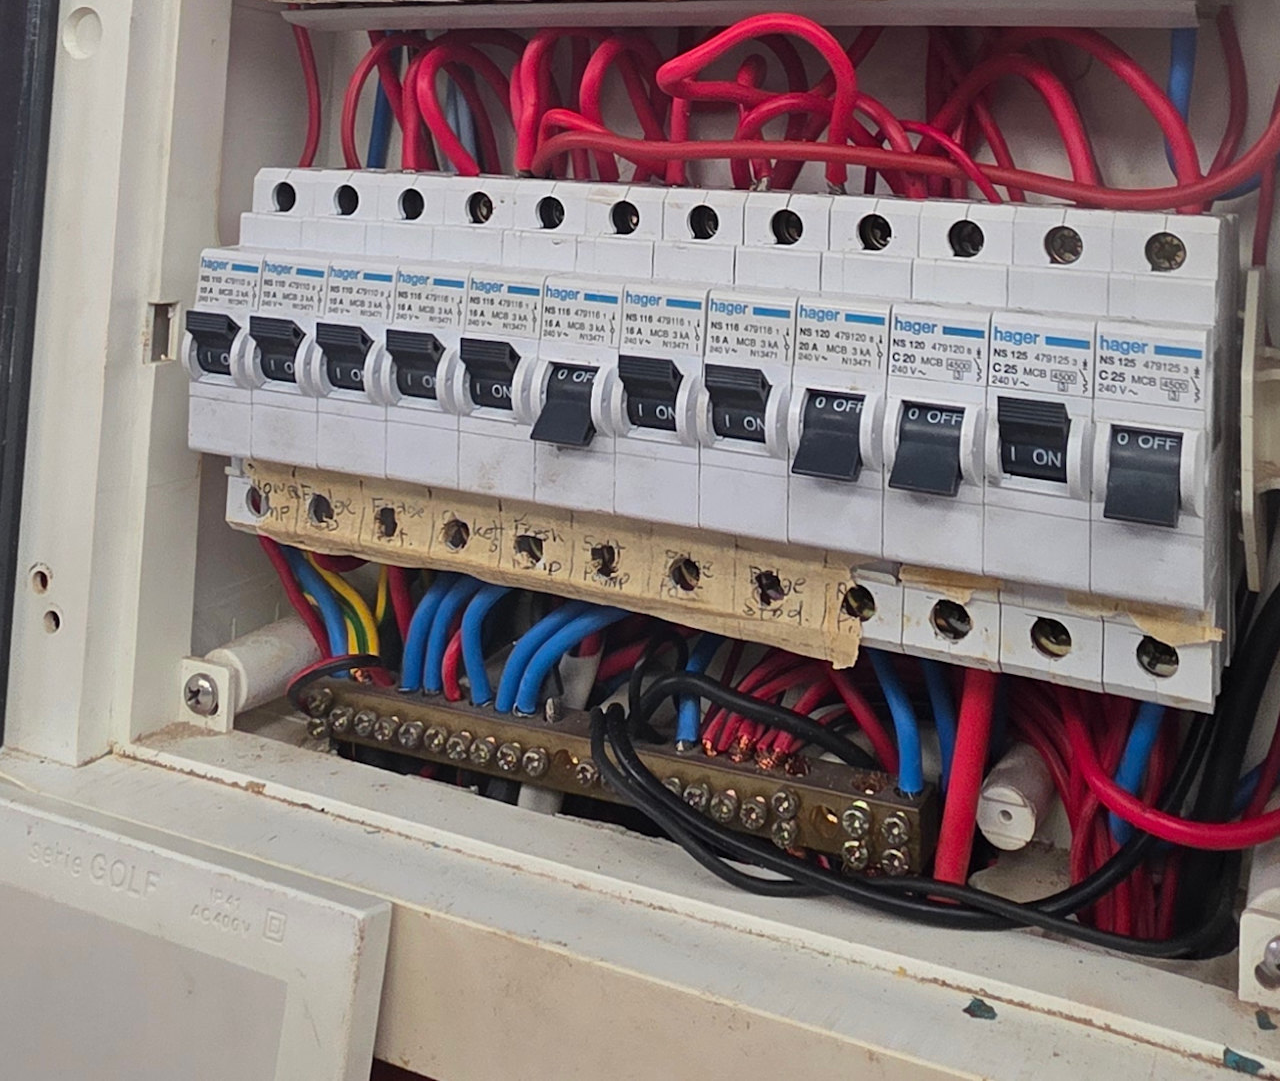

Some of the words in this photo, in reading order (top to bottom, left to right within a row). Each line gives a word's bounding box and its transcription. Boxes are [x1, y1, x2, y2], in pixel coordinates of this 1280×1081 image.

[201, 257, 229, 271] hager
[264, 261, 293, 275] hager
[328, 266, 360, 280] hager
[398, 271, 431, 286] hager
[471, 279, 504, 294] hager
[546, 285, 580, 302] hager
[625, 291, 662, 307] hager
[545, 305, 556, 315] NS
[558, 307, 570, 316] 116
[574, 309, 600, 319] 479116
[710, 300, 748, 316] hager
[800, 305, 840, 322] hager
[545, 319, 552, 327] 16
[554, 320, 561, 328] A
[568, 321, 585, 331] MCB
[589, 323, 593, 331] 3
[595, 323, 605, 333] kA
[894, 317, 937, 335] hager
[579, 333, 605, 343] N13471
[799, 327, 813, 337] NS
[815, 329, 830, 338] 120
[834, 331, 866, 342] 479120
[994, 327, 1040, 345] hager
[799, 342, 810, 351] 20
[811, 343, 818, 351] A
[826, 344, 847, 355] MCB
[852, 347, 858, 356] 3
[859, 347, 871, 357] kA
[893, 339, 906, 348] NS
[908, 340, 925, 350] 120
[931, 343, 964, 354] 479120
[1100, 335, 1148, 355] hager
[799, 352, 815, 361] 240
[842, 357, 871, 367] N13471
[892, 353, 902, 363] C
[903, 353, 916, 364] 20
[921, 356, 943, 368] MCB
[948, 360, 969, 370] 4500
[994, 348, 1008, 358] NS
[1010, 350, 1028, 360] 125
[1034, 353, 1070, 365] 479125
[892, 364, 909, 375] 240
[1099, 356, 1115, 365] NS
[1118, 357, 1137, 368] 125
[1143, 360, 1181, 373] 479125
[993, 363, 1002, 373] C
[1004, 363, 1018, 374] 25
[1023, 367, 1047, 378] MCB
[1052, 372, 1075, 382] 4500
[992, 375, 1009, 386] 240
[1099, 370, 1108, 381] C
[1110, 371, 1126, 382] 25
[1131, 375, 1156, 387] MCB
[1162, 380, 1187, 391] 4500
[1099, 384, 1117, 394] 240
[638, 403, 642, 416] I
[725, 414, 729, 428] I
[927, 410, 964, 426] OFF
[1138, 435, 1178, 450] OFF
[1011, 446, 1015, 461] I
[1032, 449, 1061, 468] ON
[89, 852, 160, 897] GOLF
